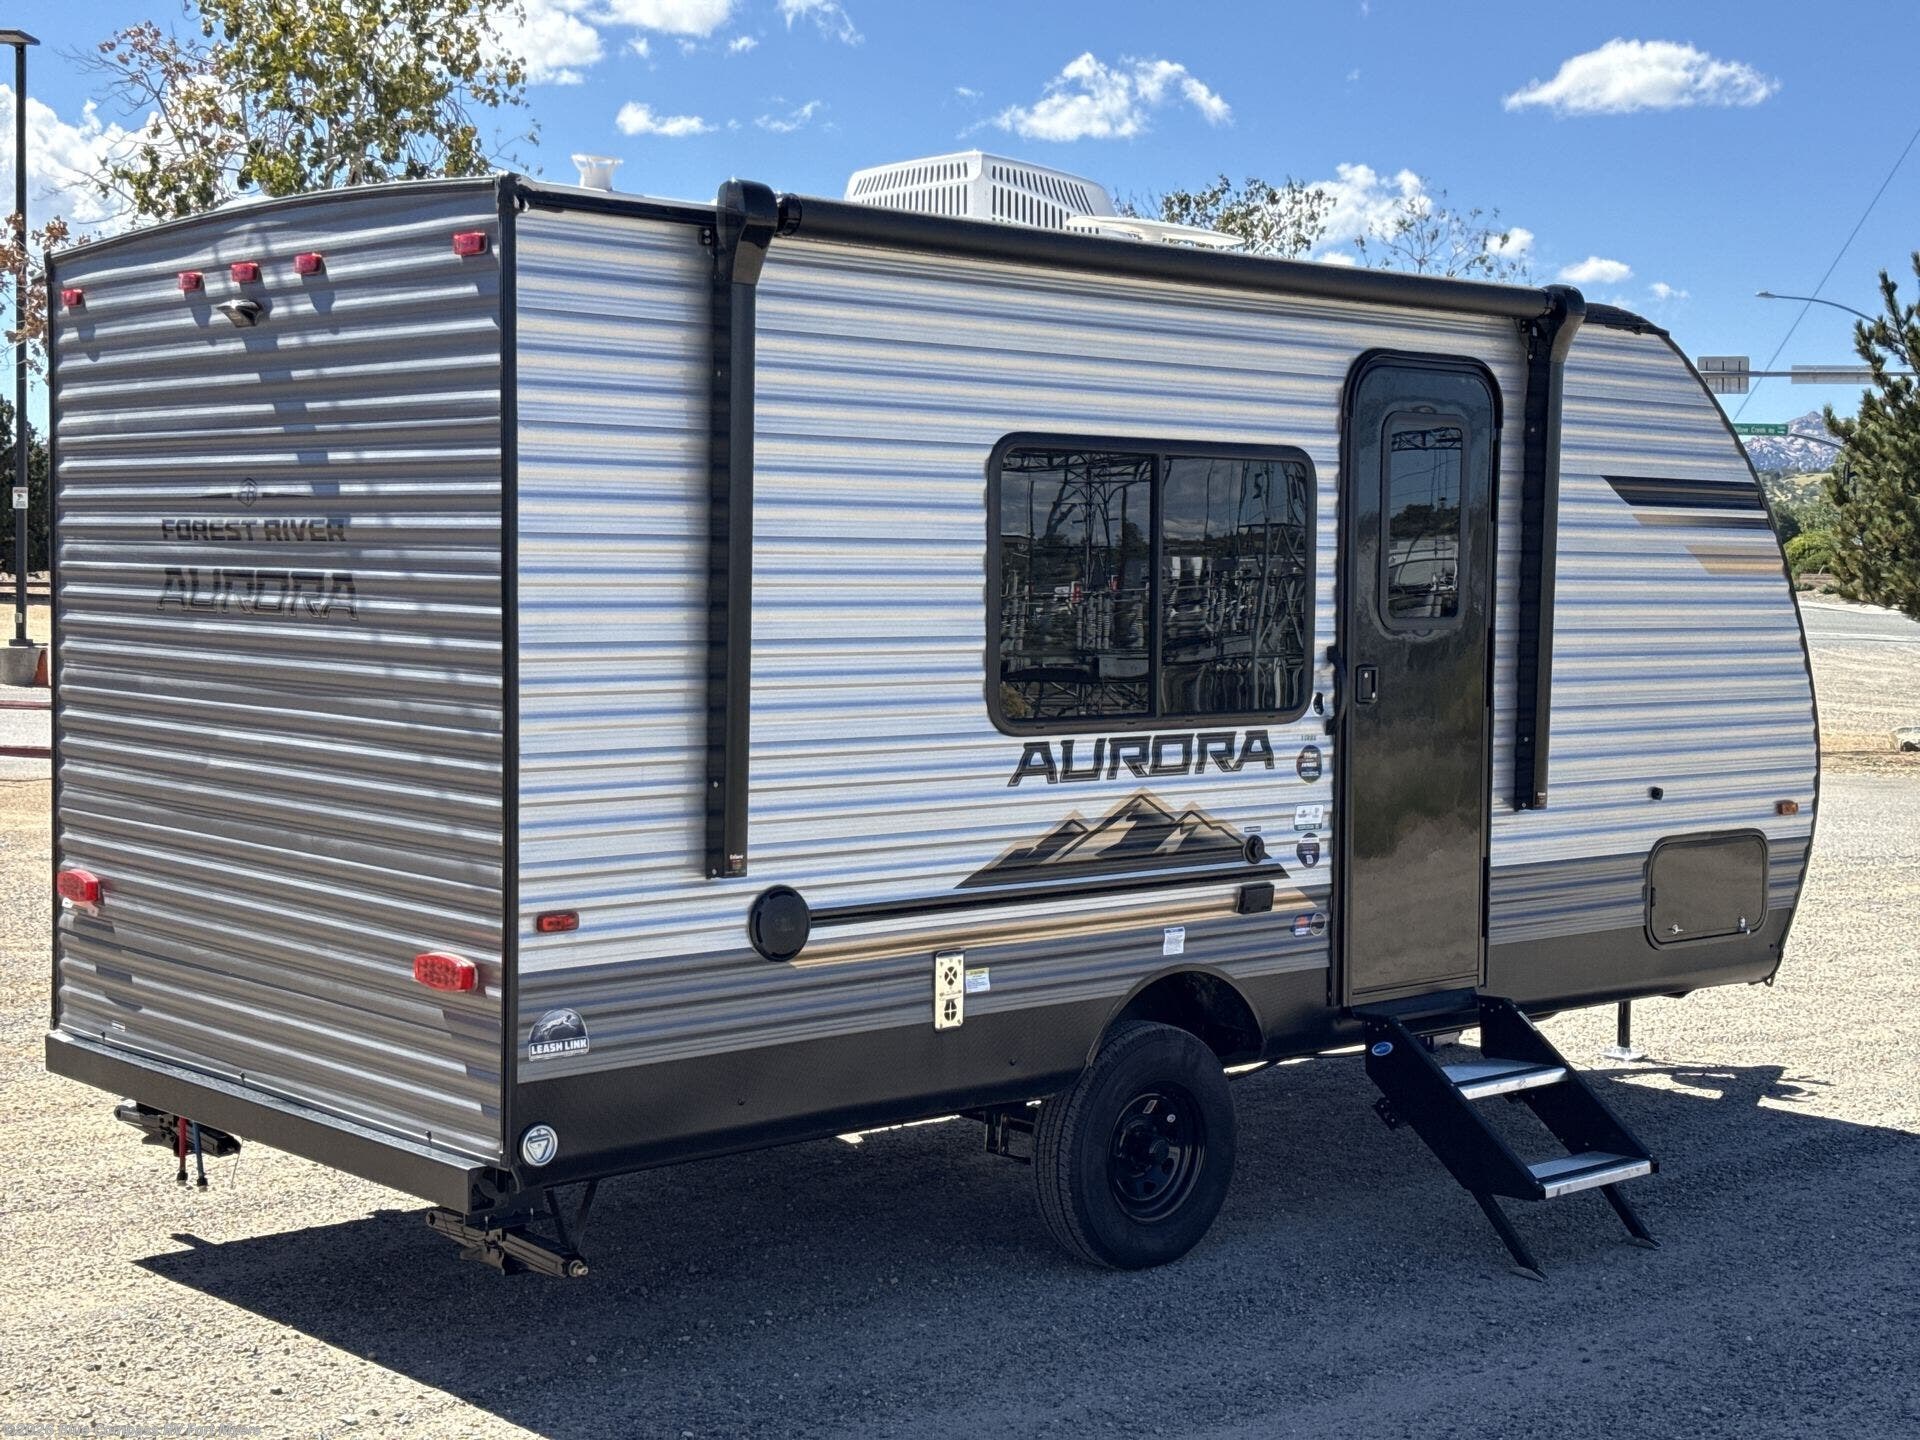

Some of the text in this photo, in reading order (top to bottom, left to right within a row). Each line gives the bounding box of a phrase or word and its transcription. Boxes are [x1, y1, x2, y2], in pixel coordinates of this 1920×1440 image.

[161, 518, 347, 542] FOREST RIVER
[157, 567, 358, 621] AURORA
[1006, 729, 1276, 787] AURORA
[531, 1039, 587, 1055] LEASH LINK
